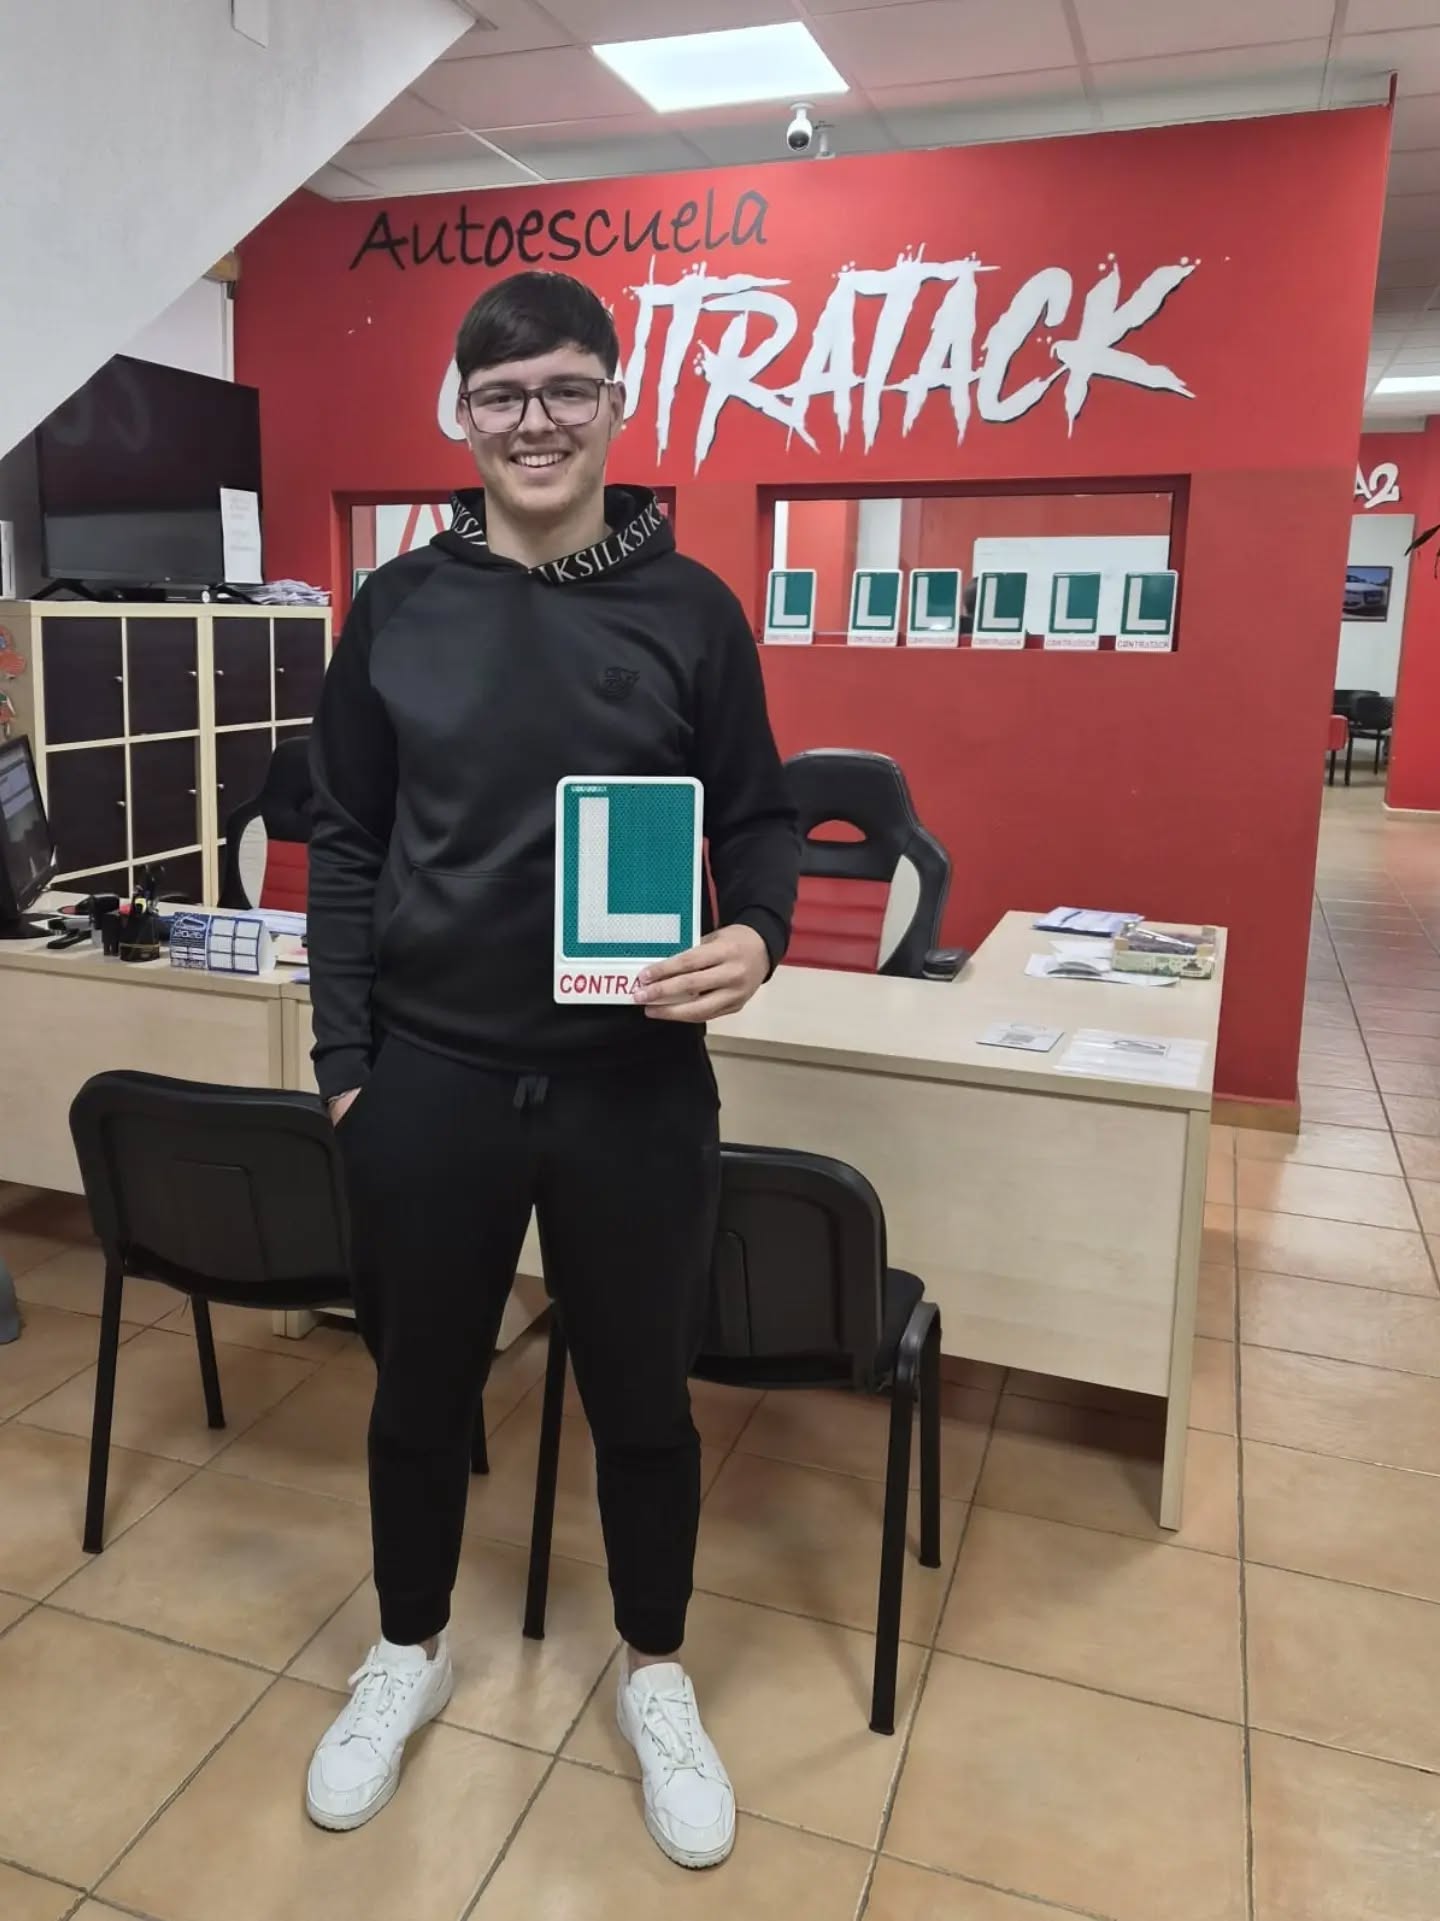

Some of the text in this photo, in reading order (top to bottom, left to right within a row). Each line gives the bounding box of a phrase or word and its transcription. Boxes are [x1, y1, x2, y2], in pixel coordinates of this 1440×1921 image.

[349, 188, 769, 270] Autoescuela
[437, 242, 1197, 476] TRATACK
[771, 576, 808, 626] L
[855, 576, 892, 627] L
[914, 576, 953, 628] L
[981, 577, 1020, 629] L
[1053, 577, 1095, 630] L
[1125, 577, 1168, 631] L
[577, 796, 681, 944] L
